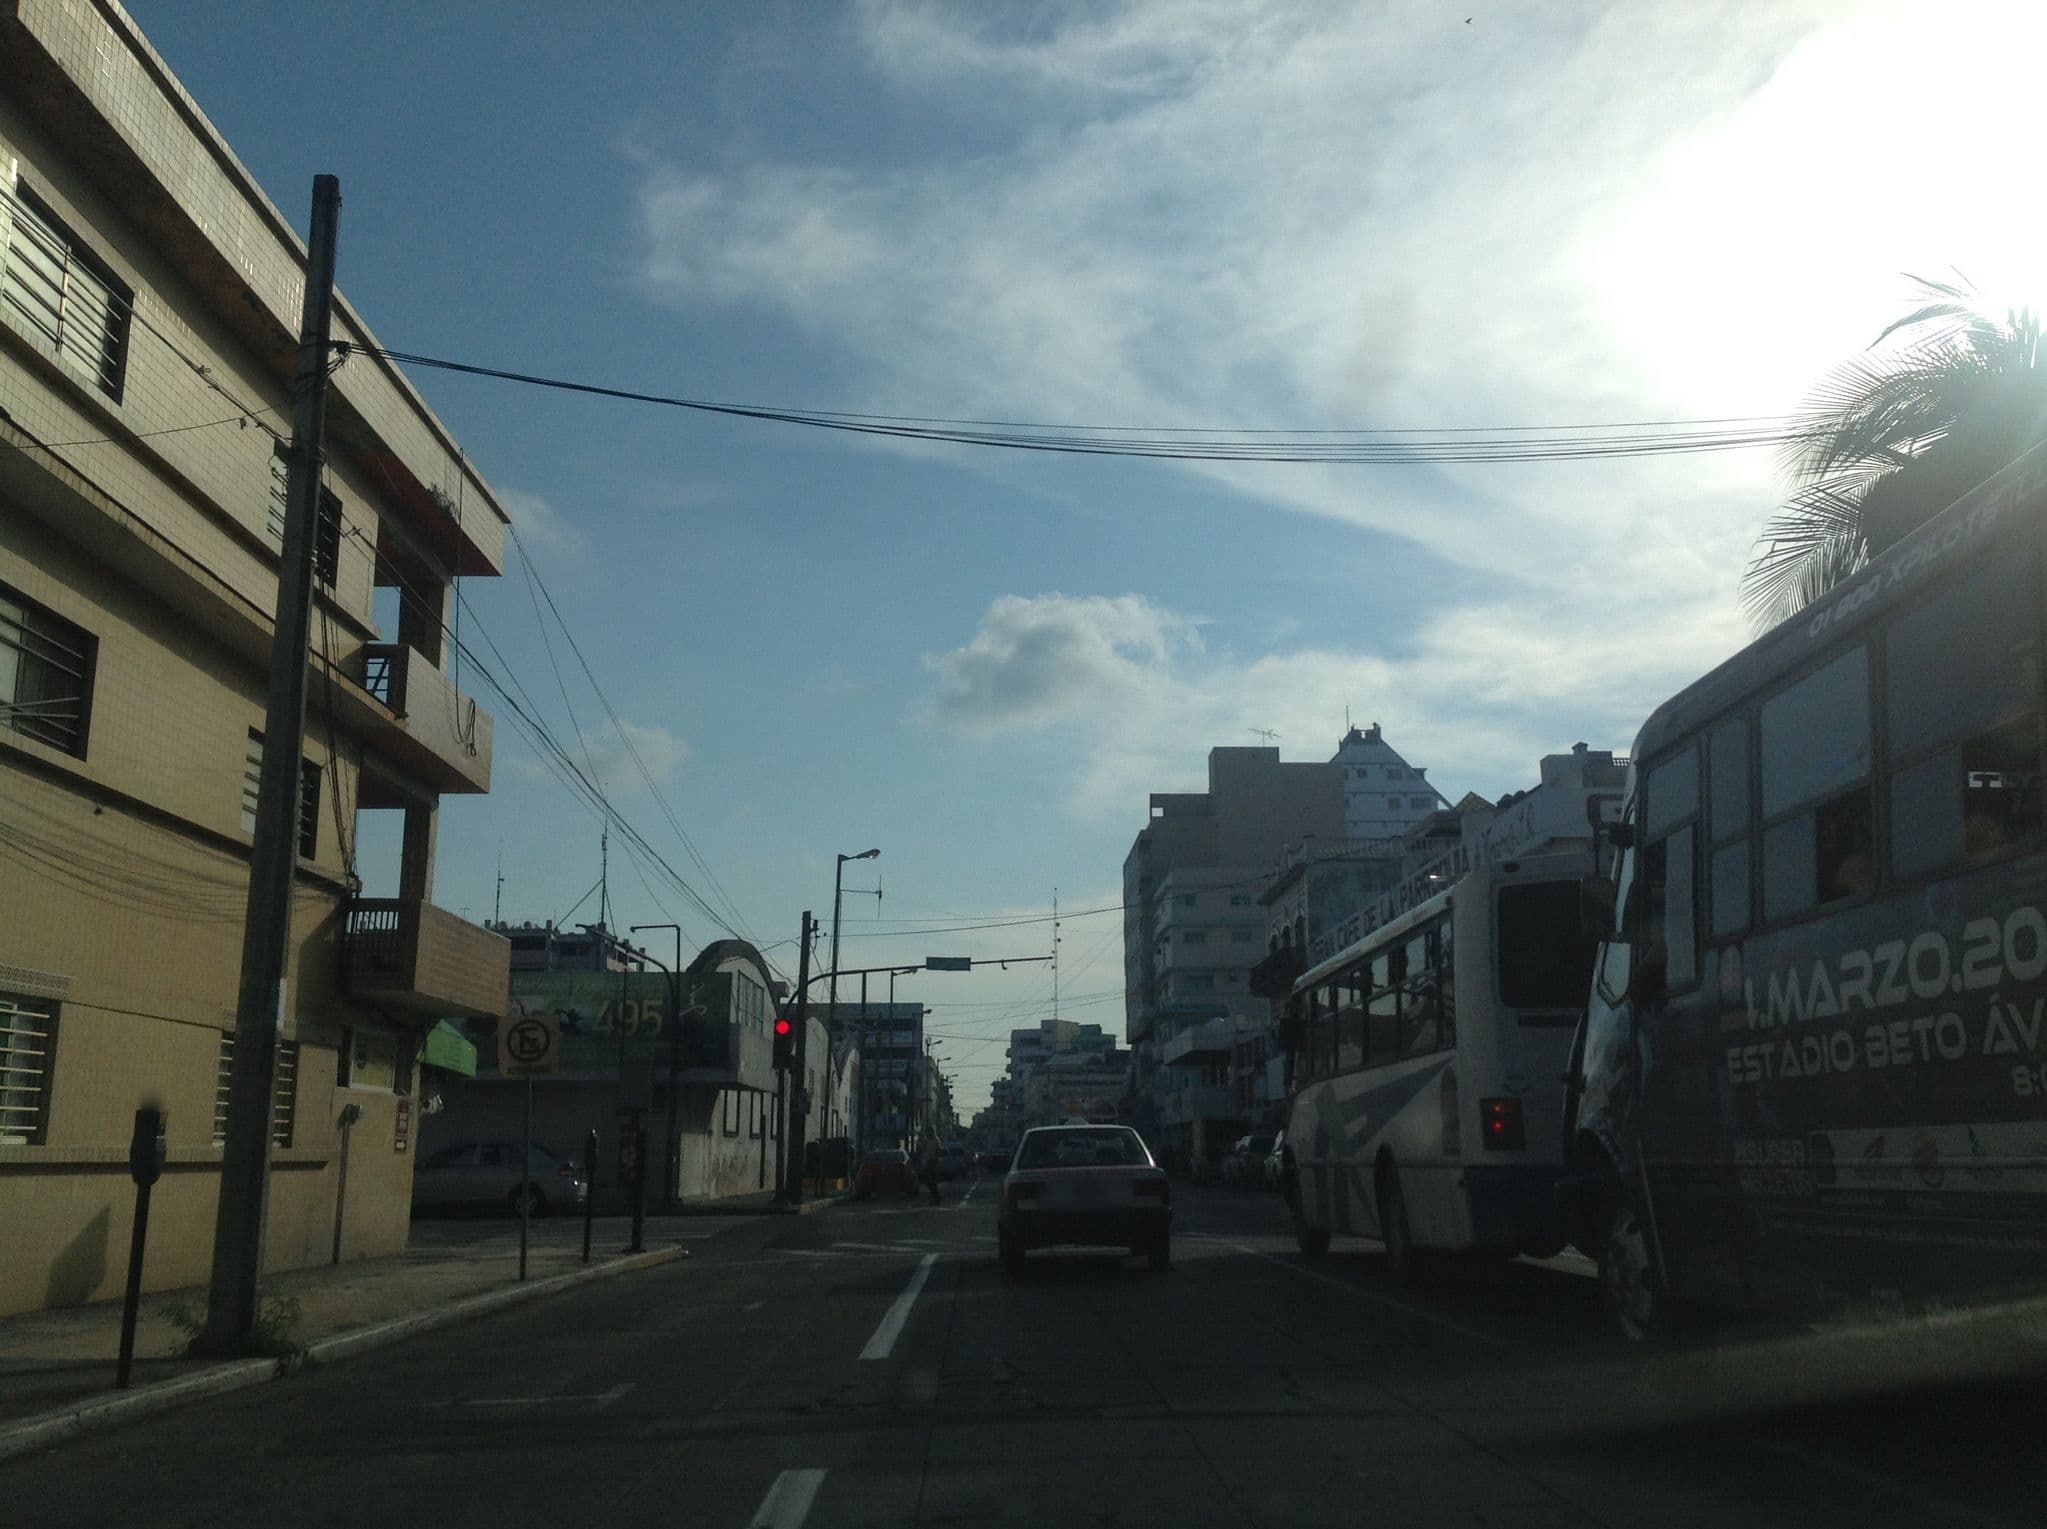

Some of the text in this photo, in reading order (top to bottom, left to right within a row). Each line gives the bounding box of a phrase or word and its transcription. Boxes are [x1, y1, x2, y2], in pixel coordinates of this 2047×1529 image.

[591, 999, 664, 1037] 495
[1726, 1029, 1856, 1085] ESTADIO
[1865, 1012, 1968, 1069] BETO
